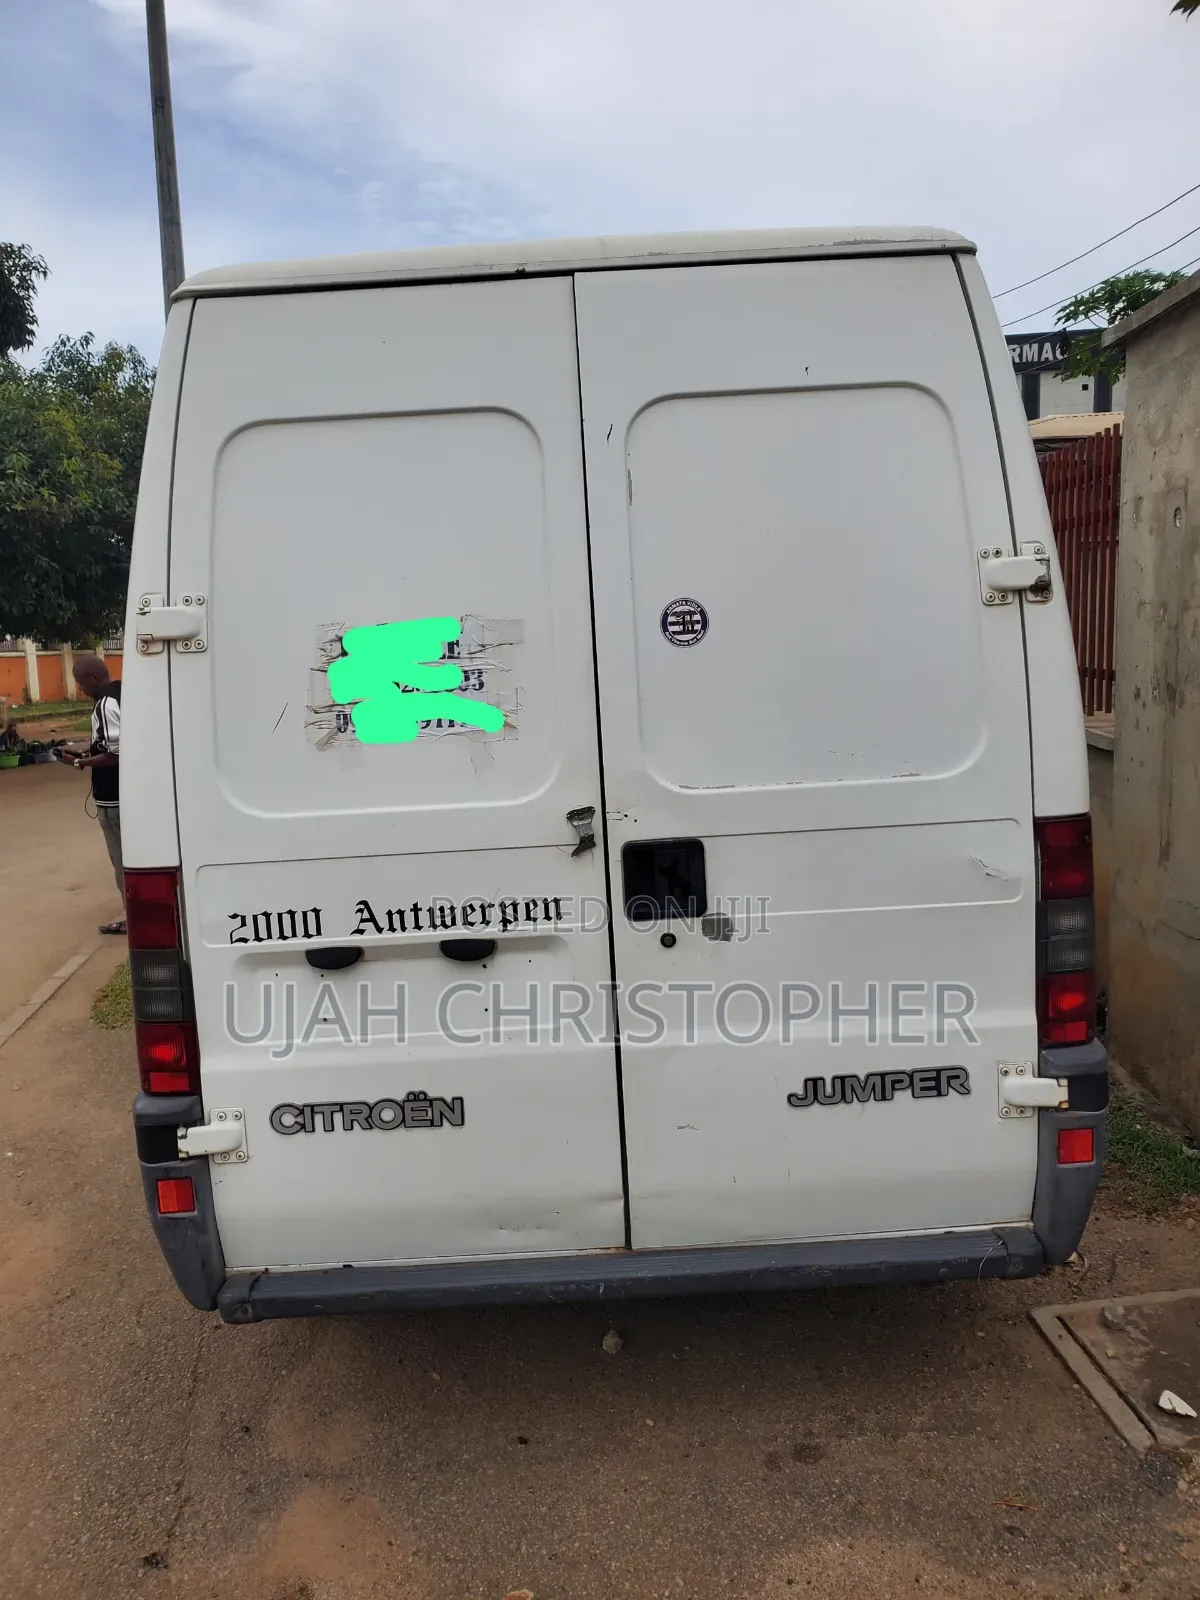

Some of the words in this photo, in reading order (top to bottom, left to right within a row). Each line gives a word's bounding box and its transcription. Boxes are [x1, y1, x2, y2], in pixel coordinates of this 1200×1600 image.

[686, 601, 701, 612] VIOLA
[227, 906, 323, 944] 2000
[349, 896, 563, 935] Antwerpen
[787, 1065, 971, 1109] JUMPER
[269, 1089, 466, 1135] CITROËN
